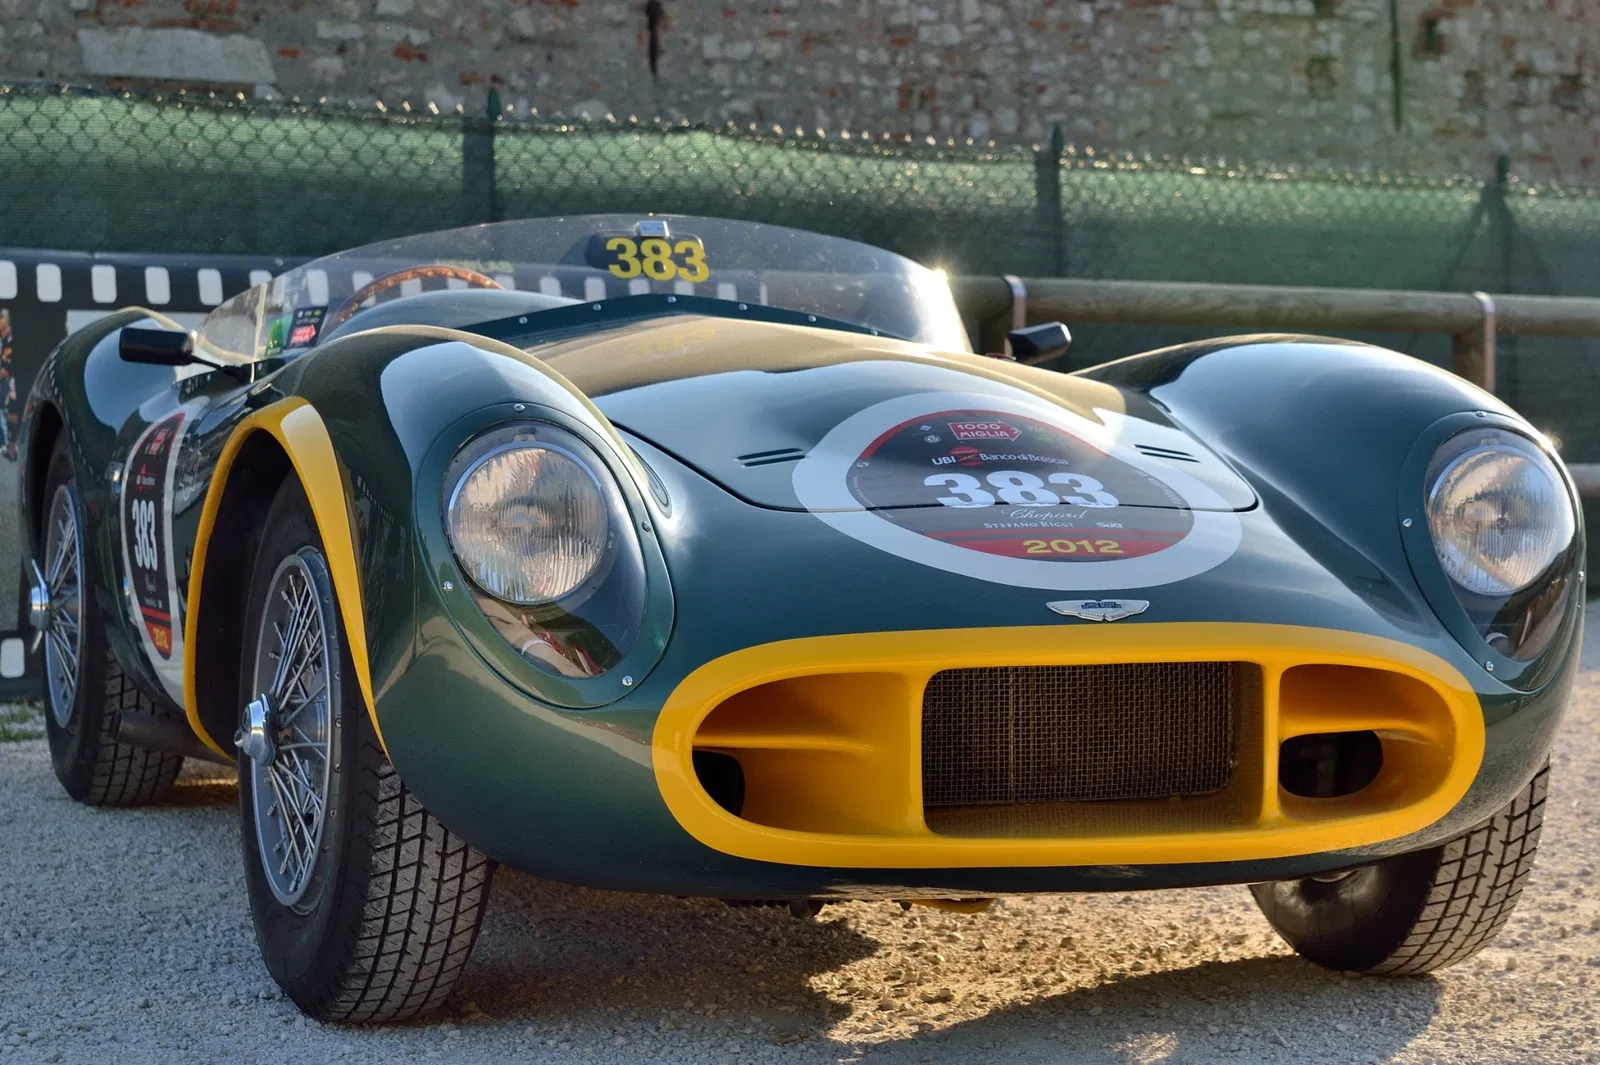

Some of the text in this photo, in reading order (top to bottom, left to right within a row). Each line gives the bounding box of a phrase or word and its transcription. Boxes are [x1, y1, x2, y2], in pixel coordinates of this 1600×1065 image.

[606, 237, 709, 282] 383
[957, 423, 1001, 431] 1000
[959, 430, 1010, 438] MIGLIA
[932, 456, 957, 466] UBI
[923, 470, 1120, 509] 383
[1001, 509, 1089, 520] Chopard
[132, 499, 158, 571] 383
[1022, 539, 1124, 554] 2012
